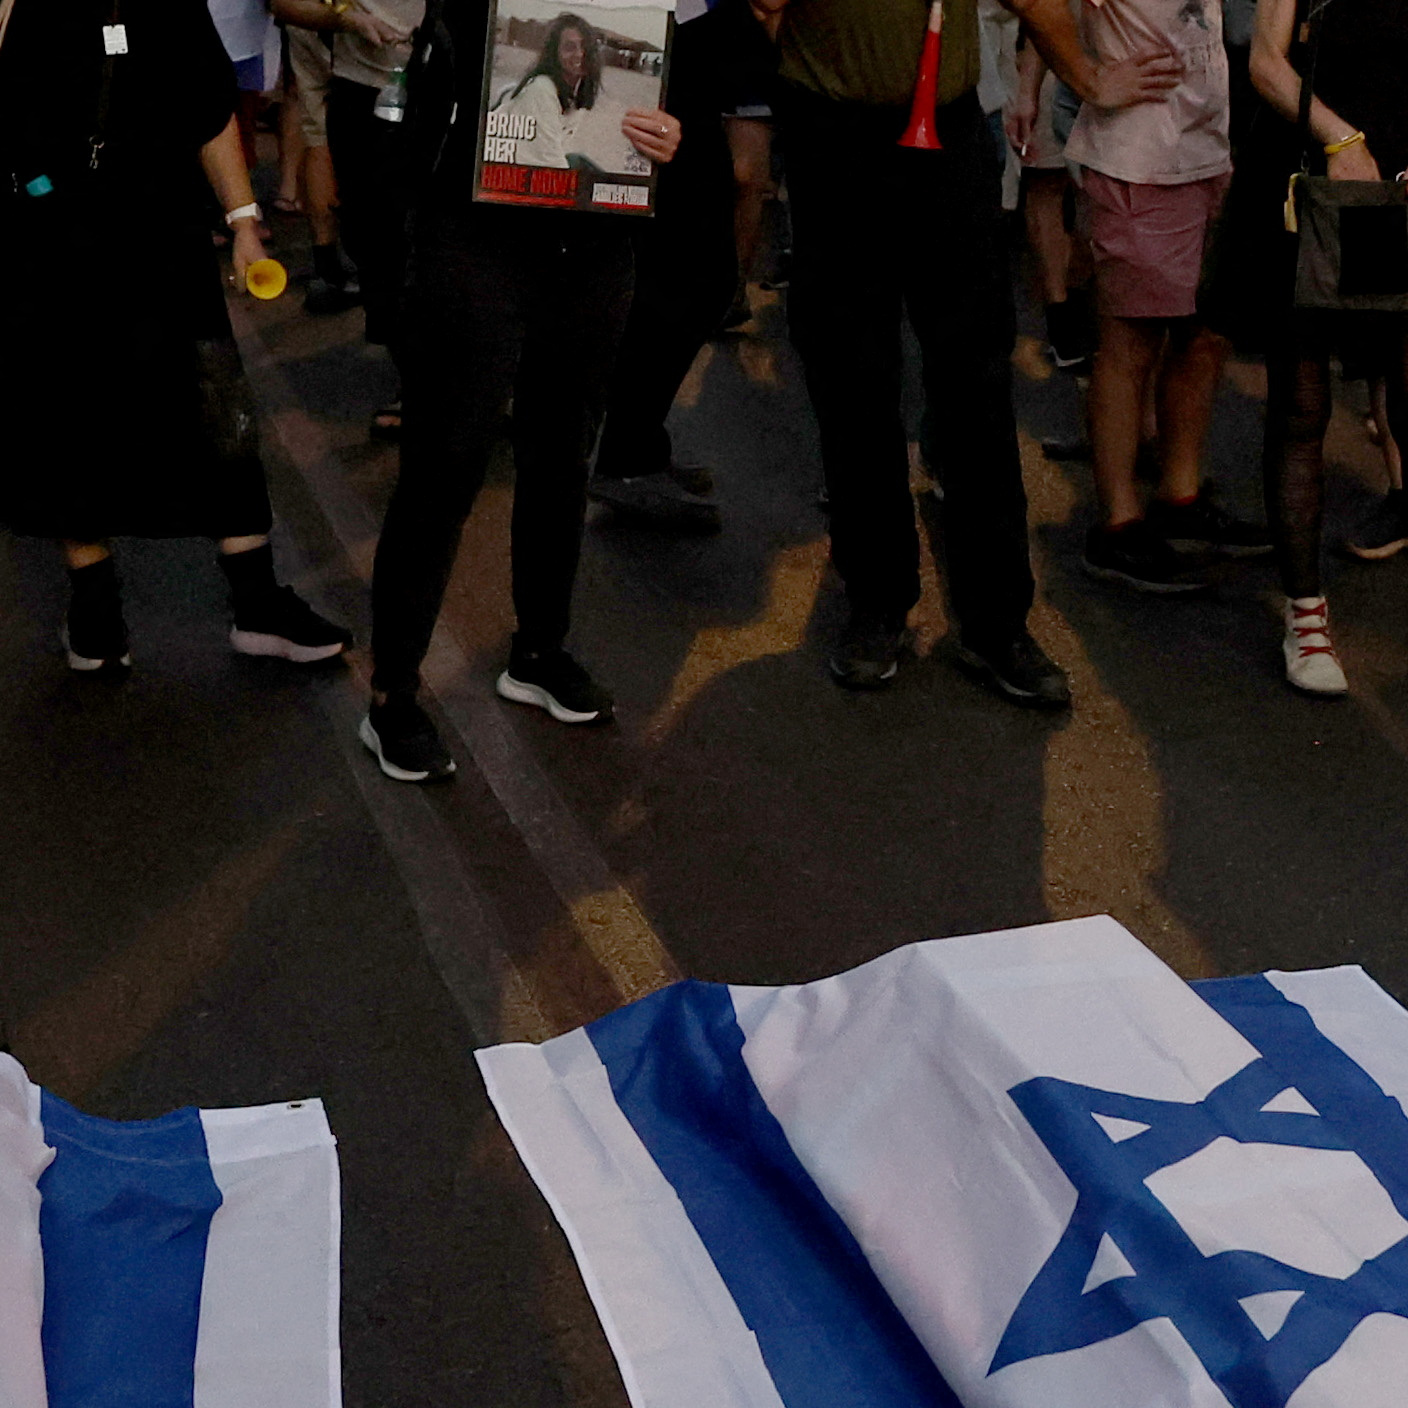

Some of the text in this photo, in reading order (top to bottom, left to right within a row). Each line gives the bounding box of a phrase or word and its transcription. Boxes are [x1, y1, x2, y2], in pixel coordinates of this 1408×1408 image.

[486, 110, 537, 141] BRING
[483, 137, 518, 164] HER
[480, 164, 528, 193] HOME
[529, 168, 580, 197] NOW!
